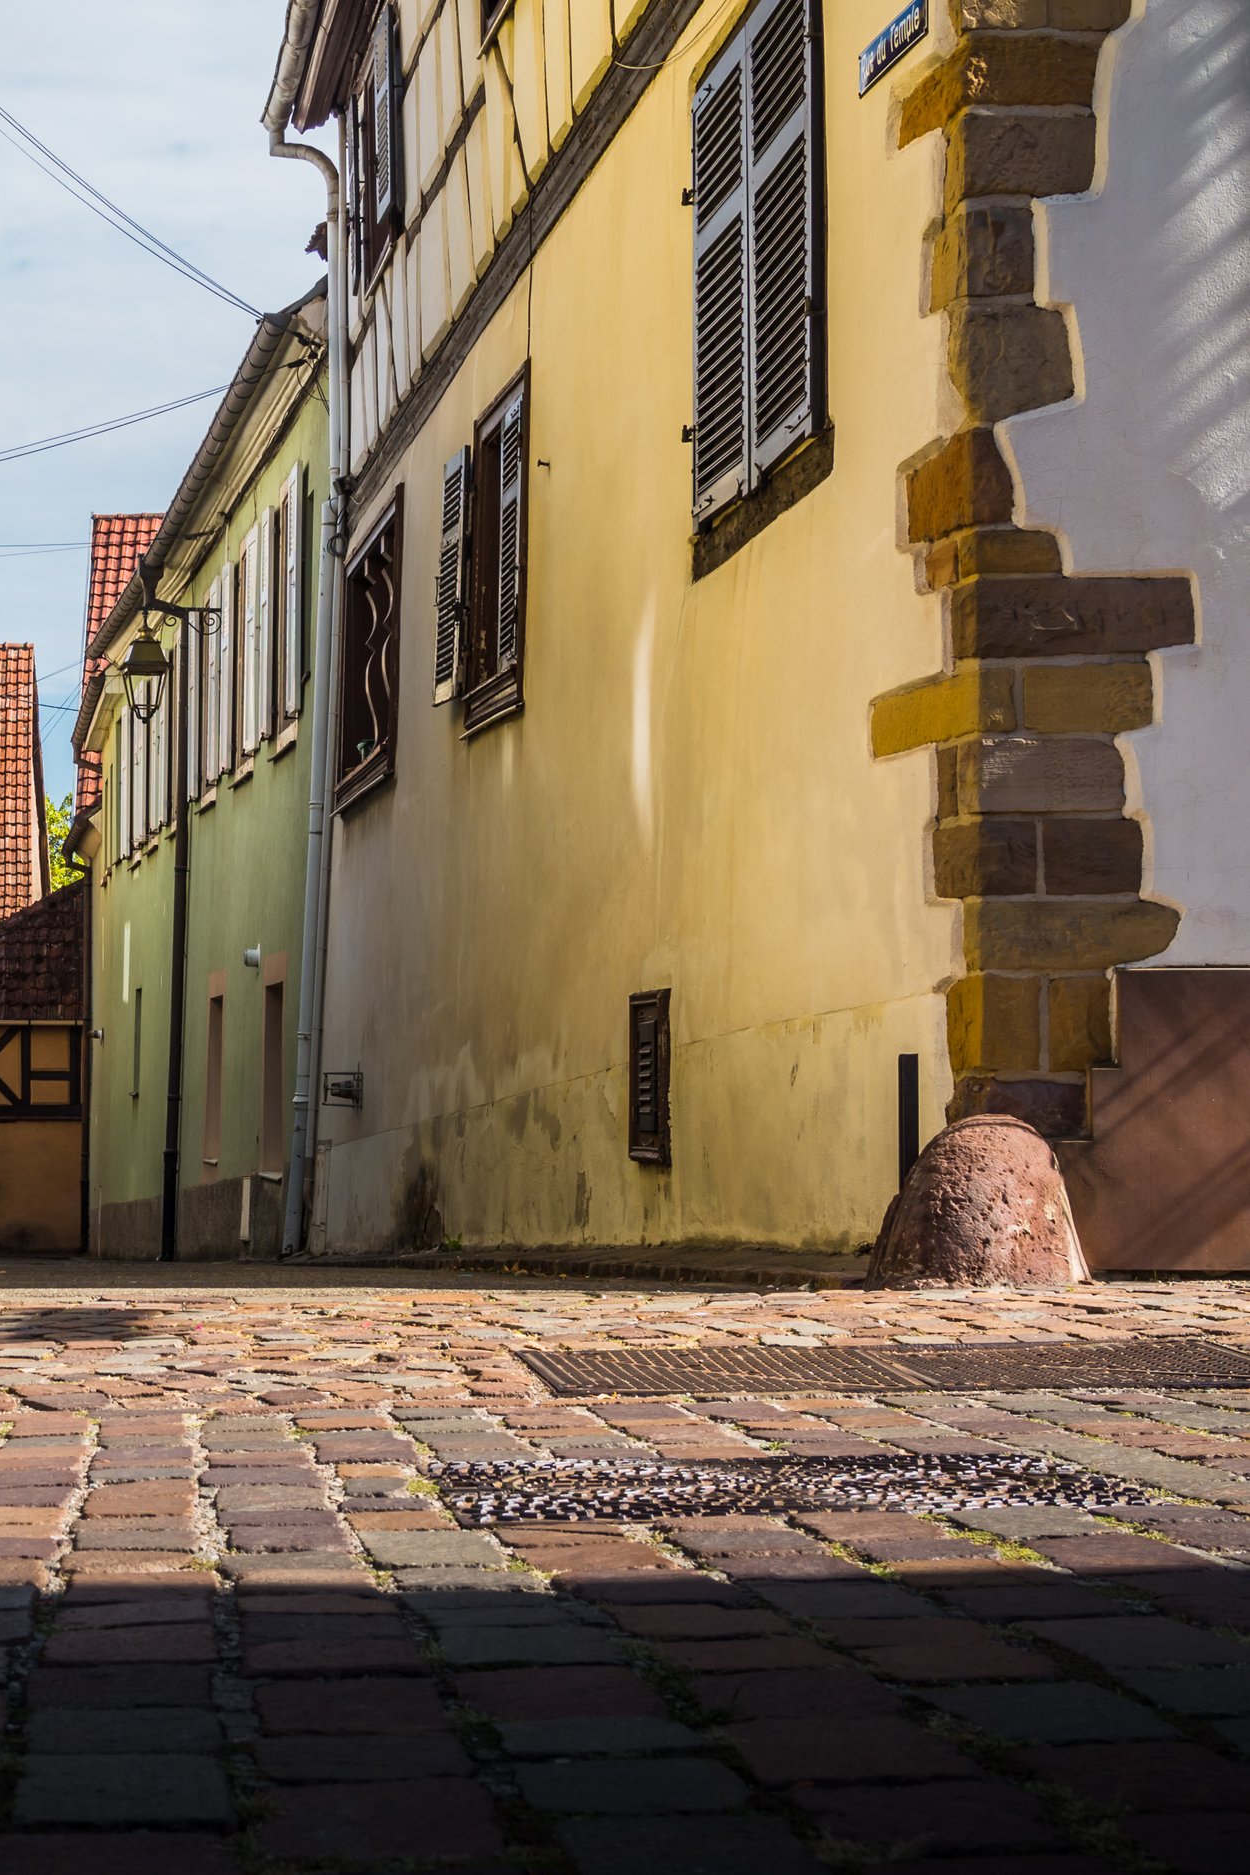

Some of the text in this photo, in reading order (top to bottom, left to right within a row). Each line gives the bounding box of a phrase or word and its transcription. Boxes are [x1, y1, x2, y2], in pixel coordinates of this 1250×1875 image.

[861, 5, 920, 81] Rue du Temple
